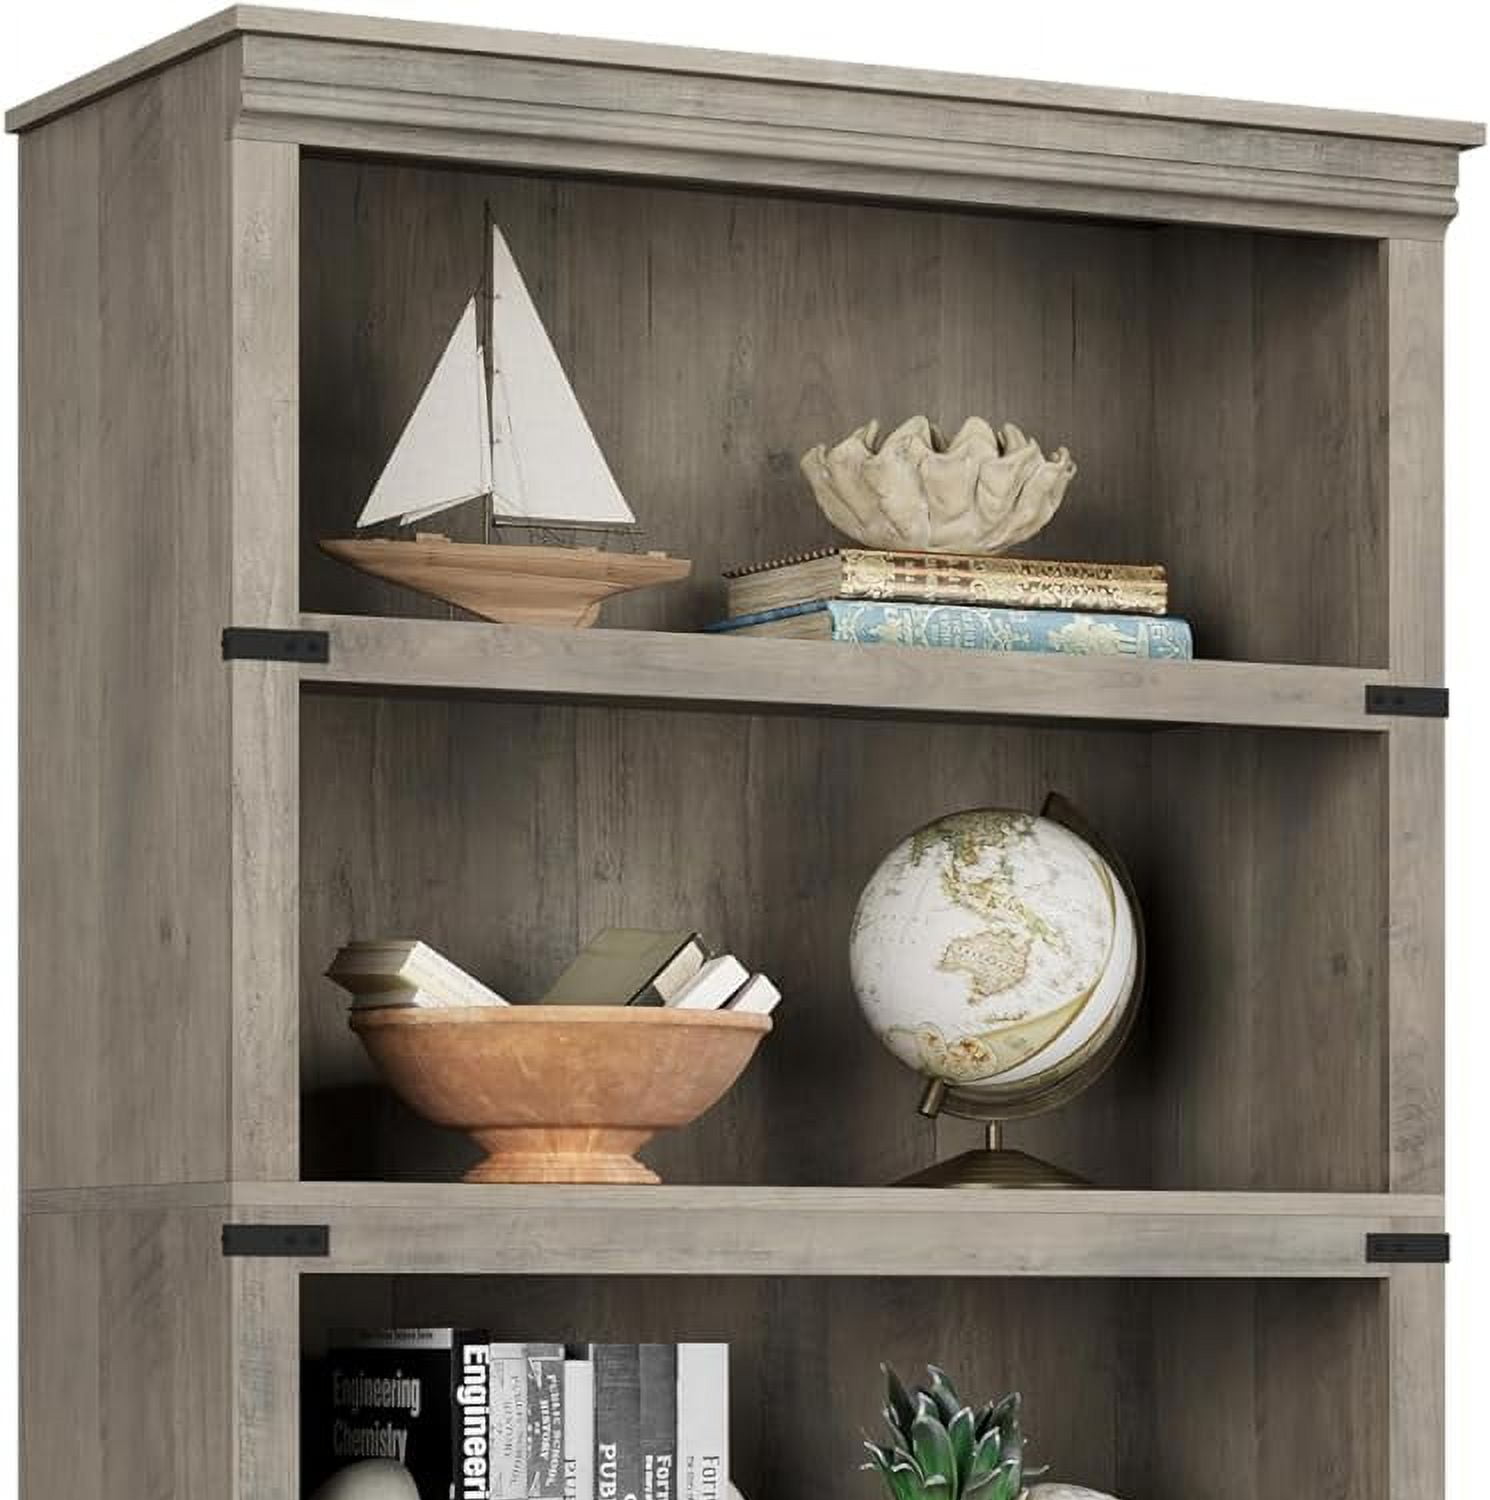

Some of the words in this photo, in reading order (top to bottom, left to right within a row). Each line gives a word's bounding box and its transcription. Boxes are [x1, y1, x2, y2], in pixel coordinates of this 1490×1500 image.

[333, 1369, 421, 1418] Engineering
[546, 1374, 561, 1425] PUBLIC
[333, 1419, 408, 1465] Chemistry
[539, 1399, 551, 1461] HISTORY
[545, 1429, 561, 1487] SCHOOL
